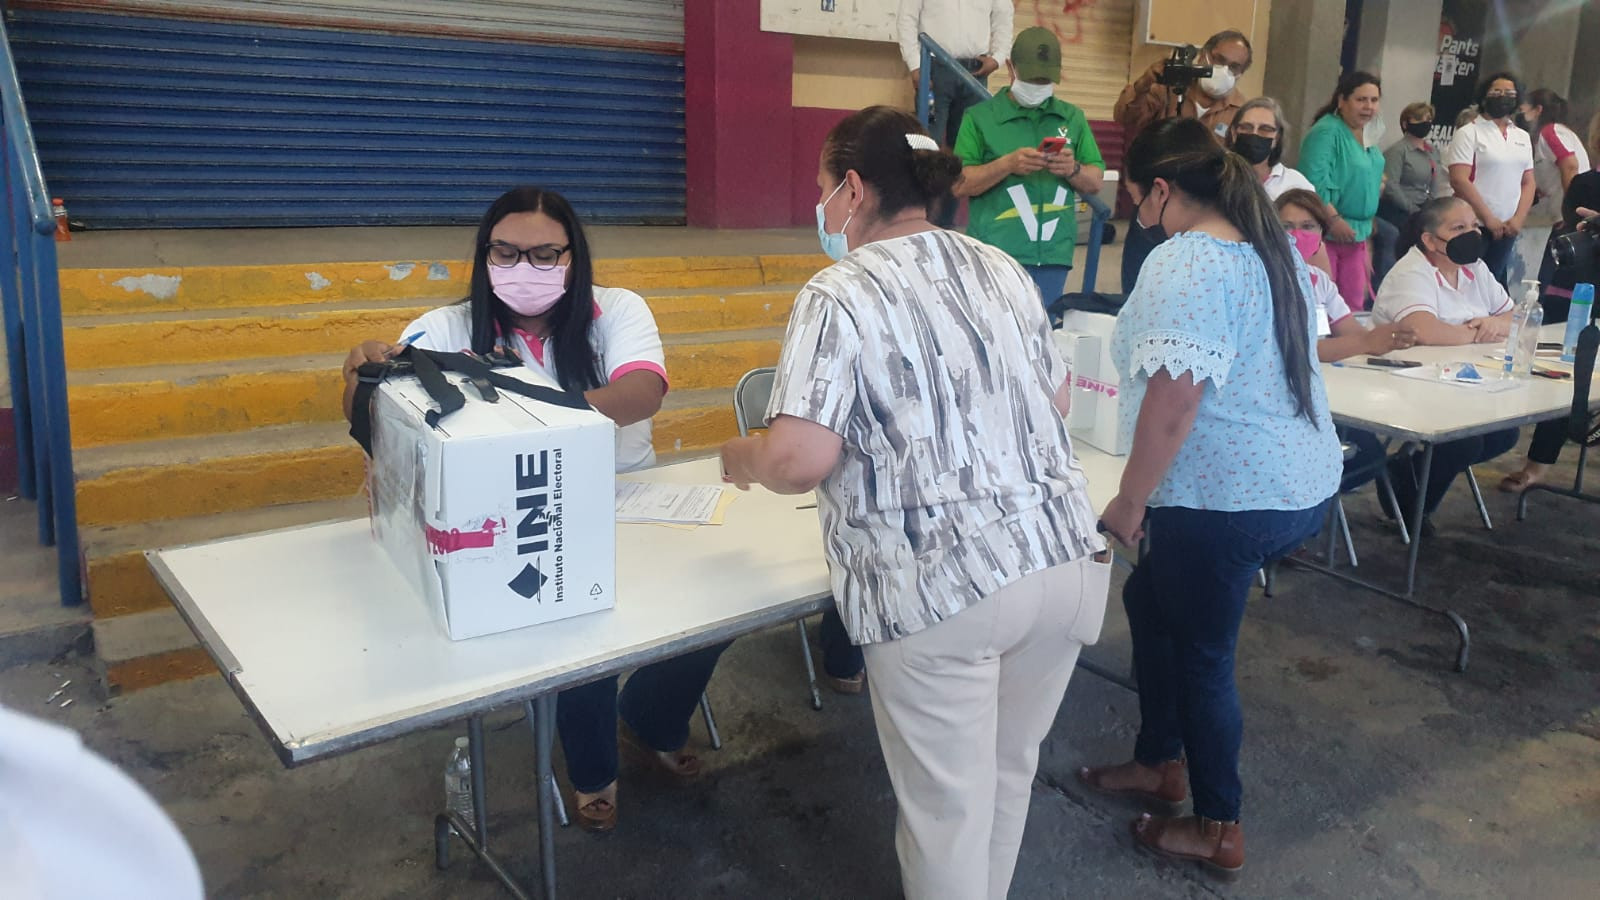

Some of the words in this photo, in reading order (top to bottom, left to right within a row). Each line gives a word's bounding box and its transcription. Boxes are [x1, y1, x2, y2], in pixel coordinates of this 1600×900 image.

[1433, 54, 1475, 76] ater
[1440, 34, 1479, 57] Parts
[1426, 124, 1456, 141] EAL
[553, 448, 563, 500] Electoral
[515, 449, 549, 556] INE
[553, 502, 563, 553] Nacional
[554, 555, 564, 603] Instituto
